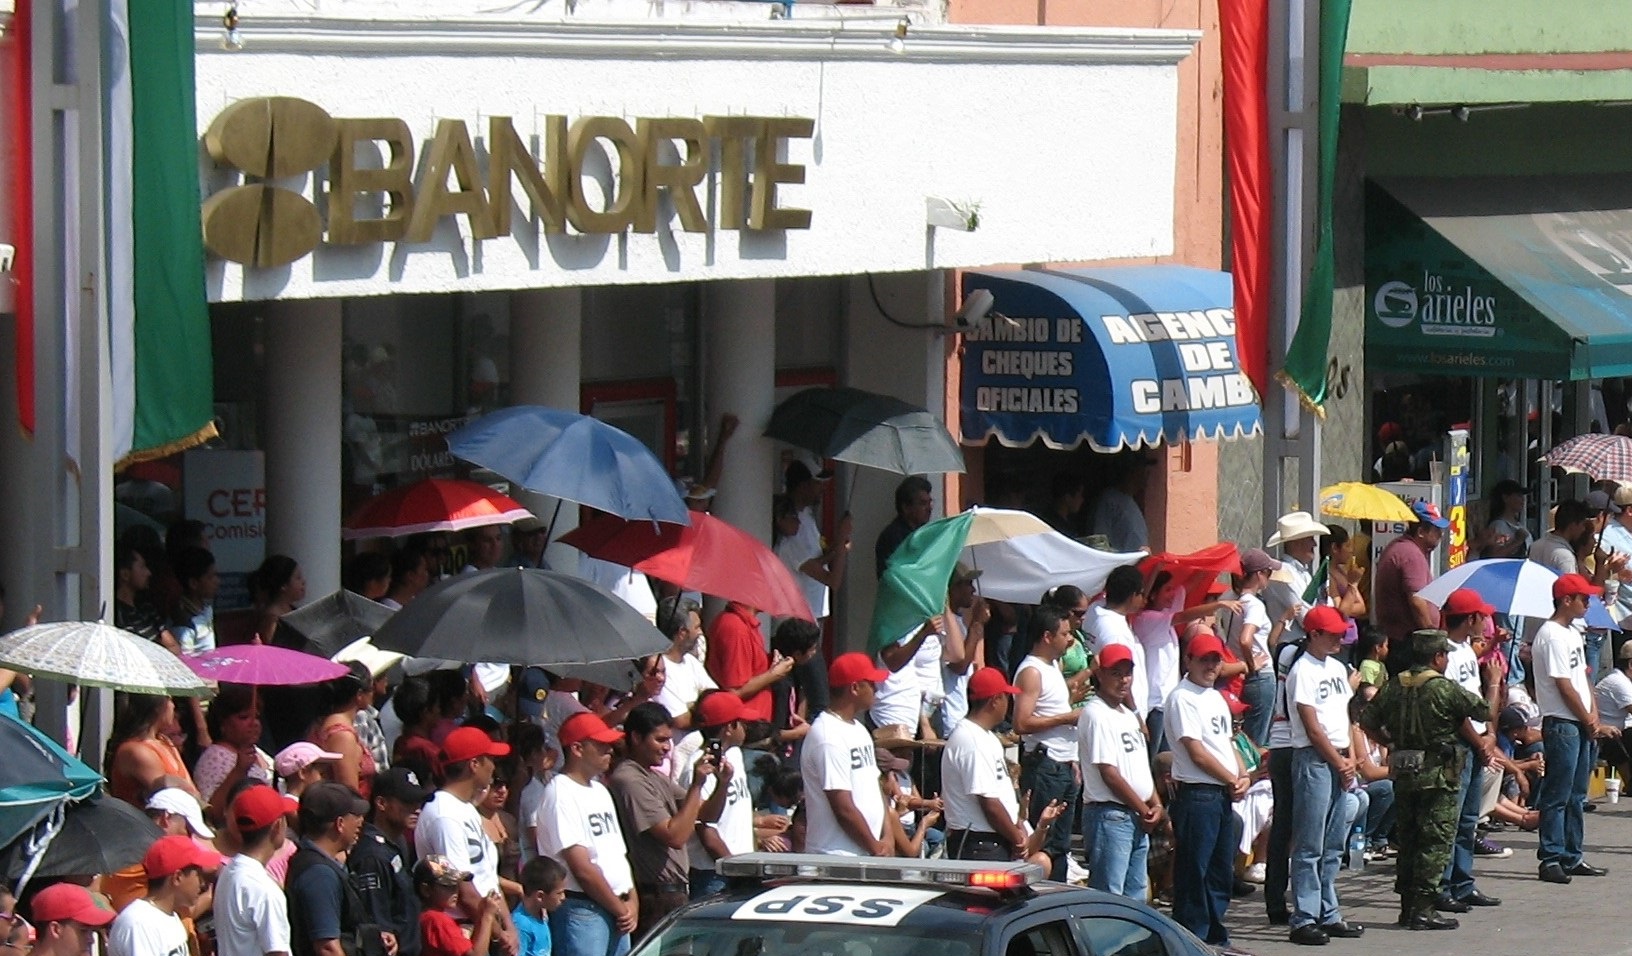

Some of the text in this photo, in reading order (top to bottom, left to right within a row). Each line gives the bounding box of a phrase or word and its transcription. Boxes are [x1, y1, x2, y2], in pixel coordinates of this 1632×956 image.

[328, 114, 816, 245] BANORTE
[1424, 270, 1442, 292] los
[1422, 286, 1496, 325] arieles
[1057, 318, 1081, 343] DE
[1102, 308, 1238, 344] AGENC
[982, 351, 1072, 379] CHEQUES
[1180, 342, 1232, 371] DE
[977, 387, 1078, 413] OFICIALES
[1131, 376, 1259, 414] CAMB
[754, 895, 903, 918] SSP
